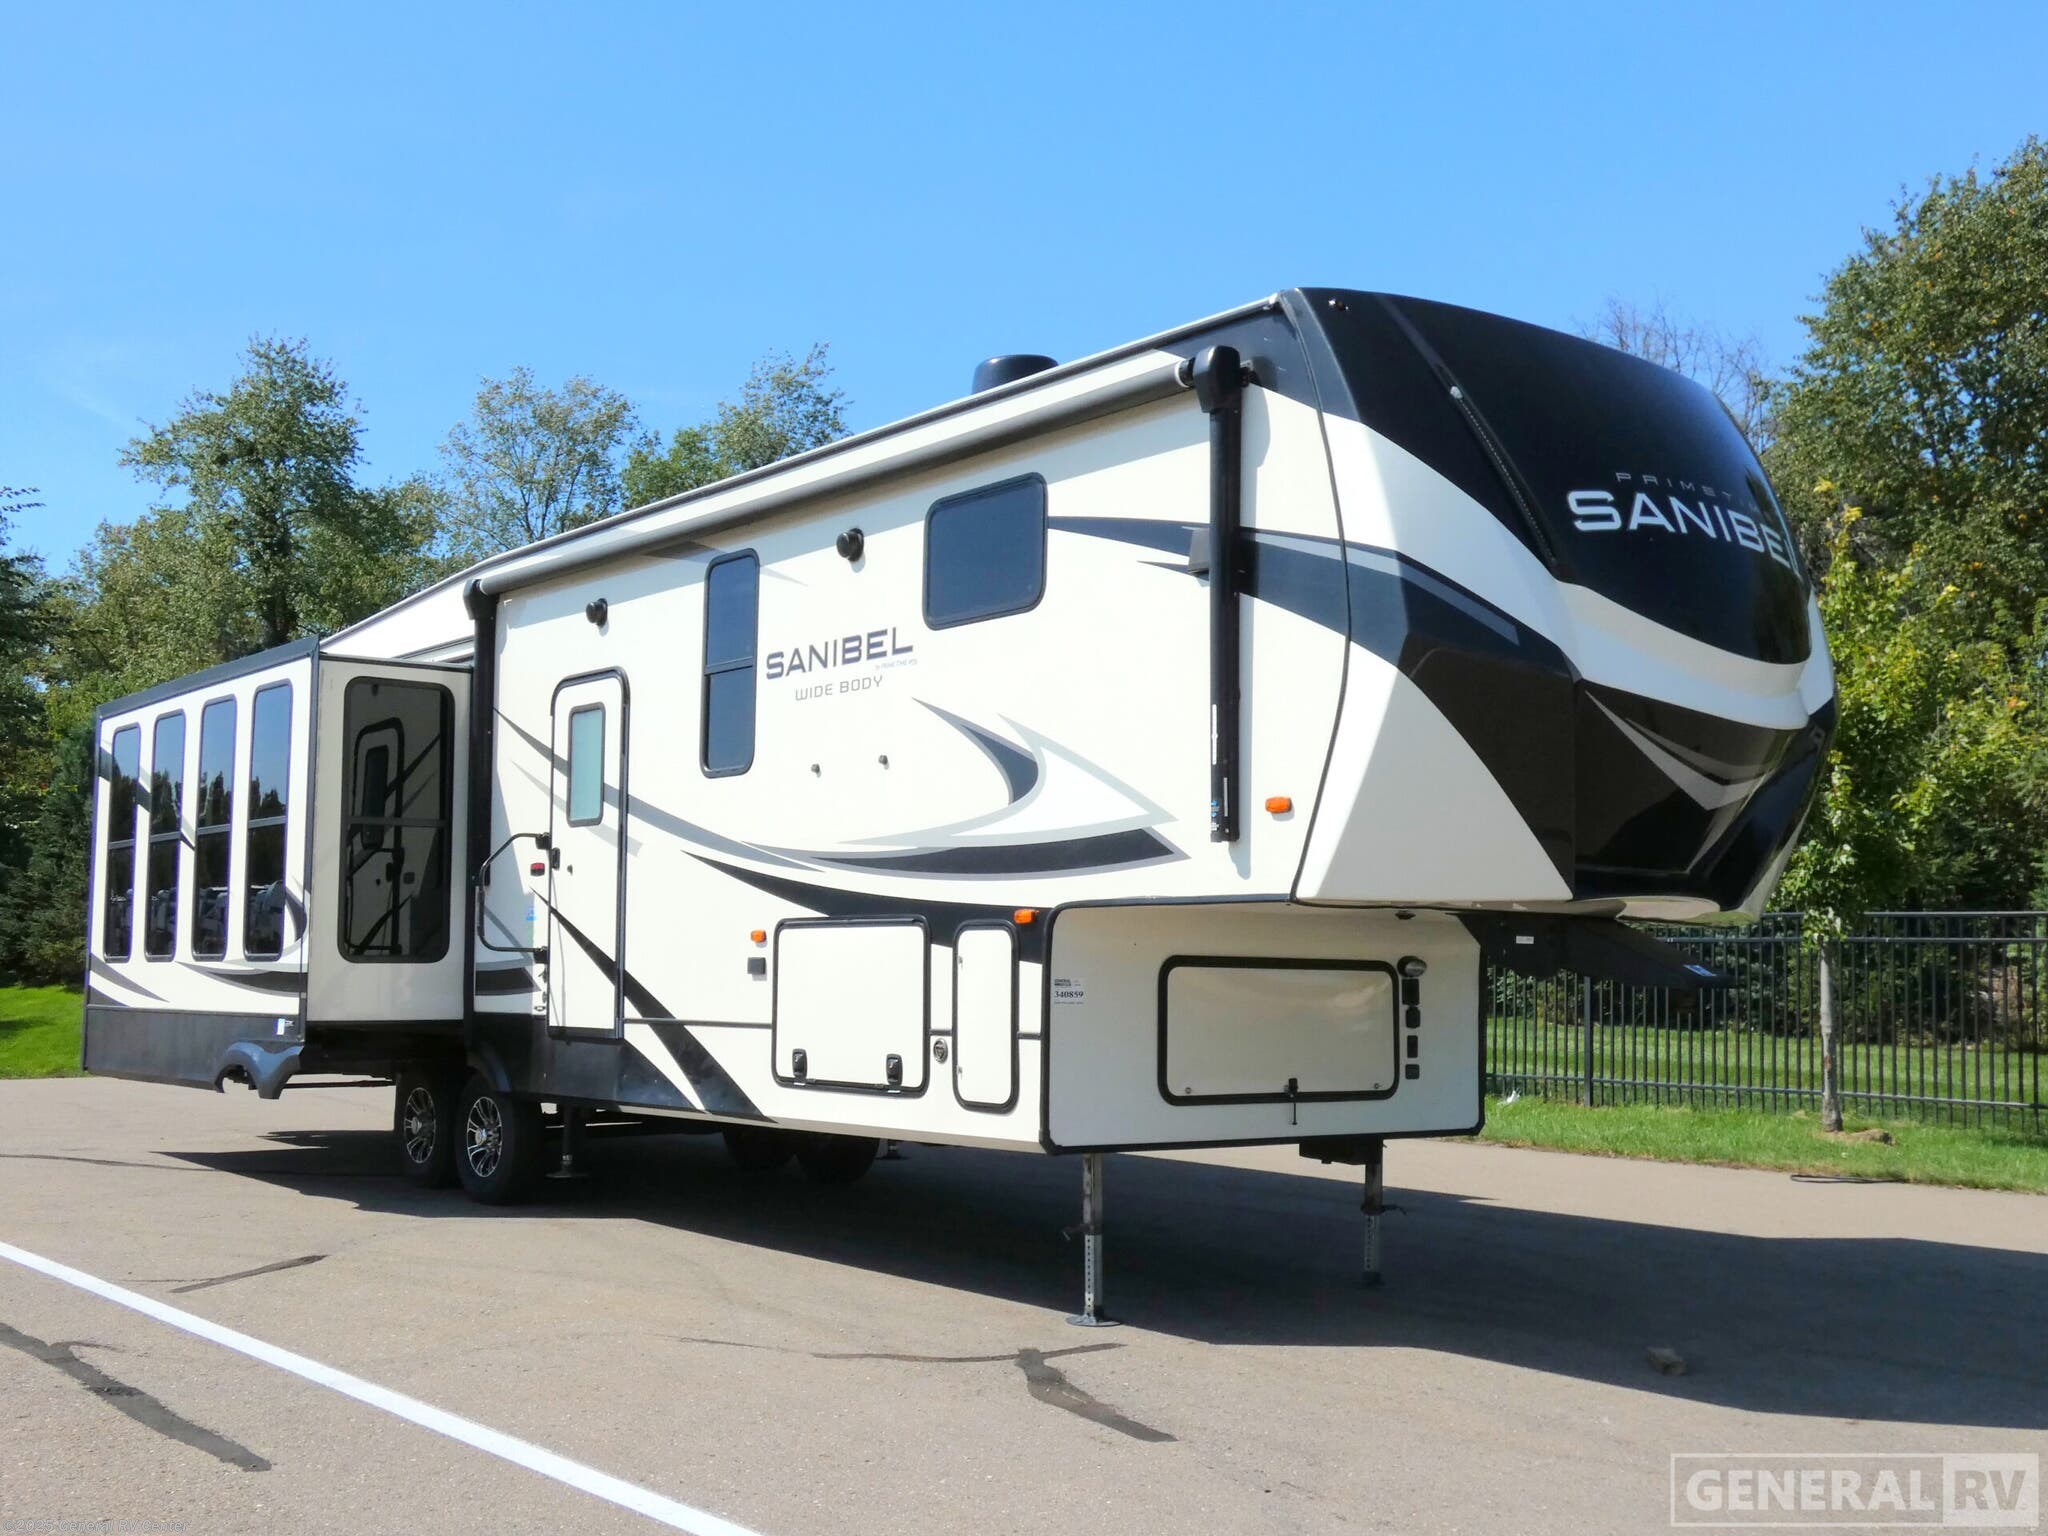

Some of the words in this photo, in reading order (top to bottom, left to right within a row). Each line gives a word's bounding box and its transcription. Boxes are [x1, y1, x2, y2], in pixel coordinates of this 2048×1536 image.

[766, 627, 913, 680] SANIBEL
[795, 683, 833, 701] WIDE
[839, 675, 883, 693] BODY
[1055, 990, 1084, 999] 340859
